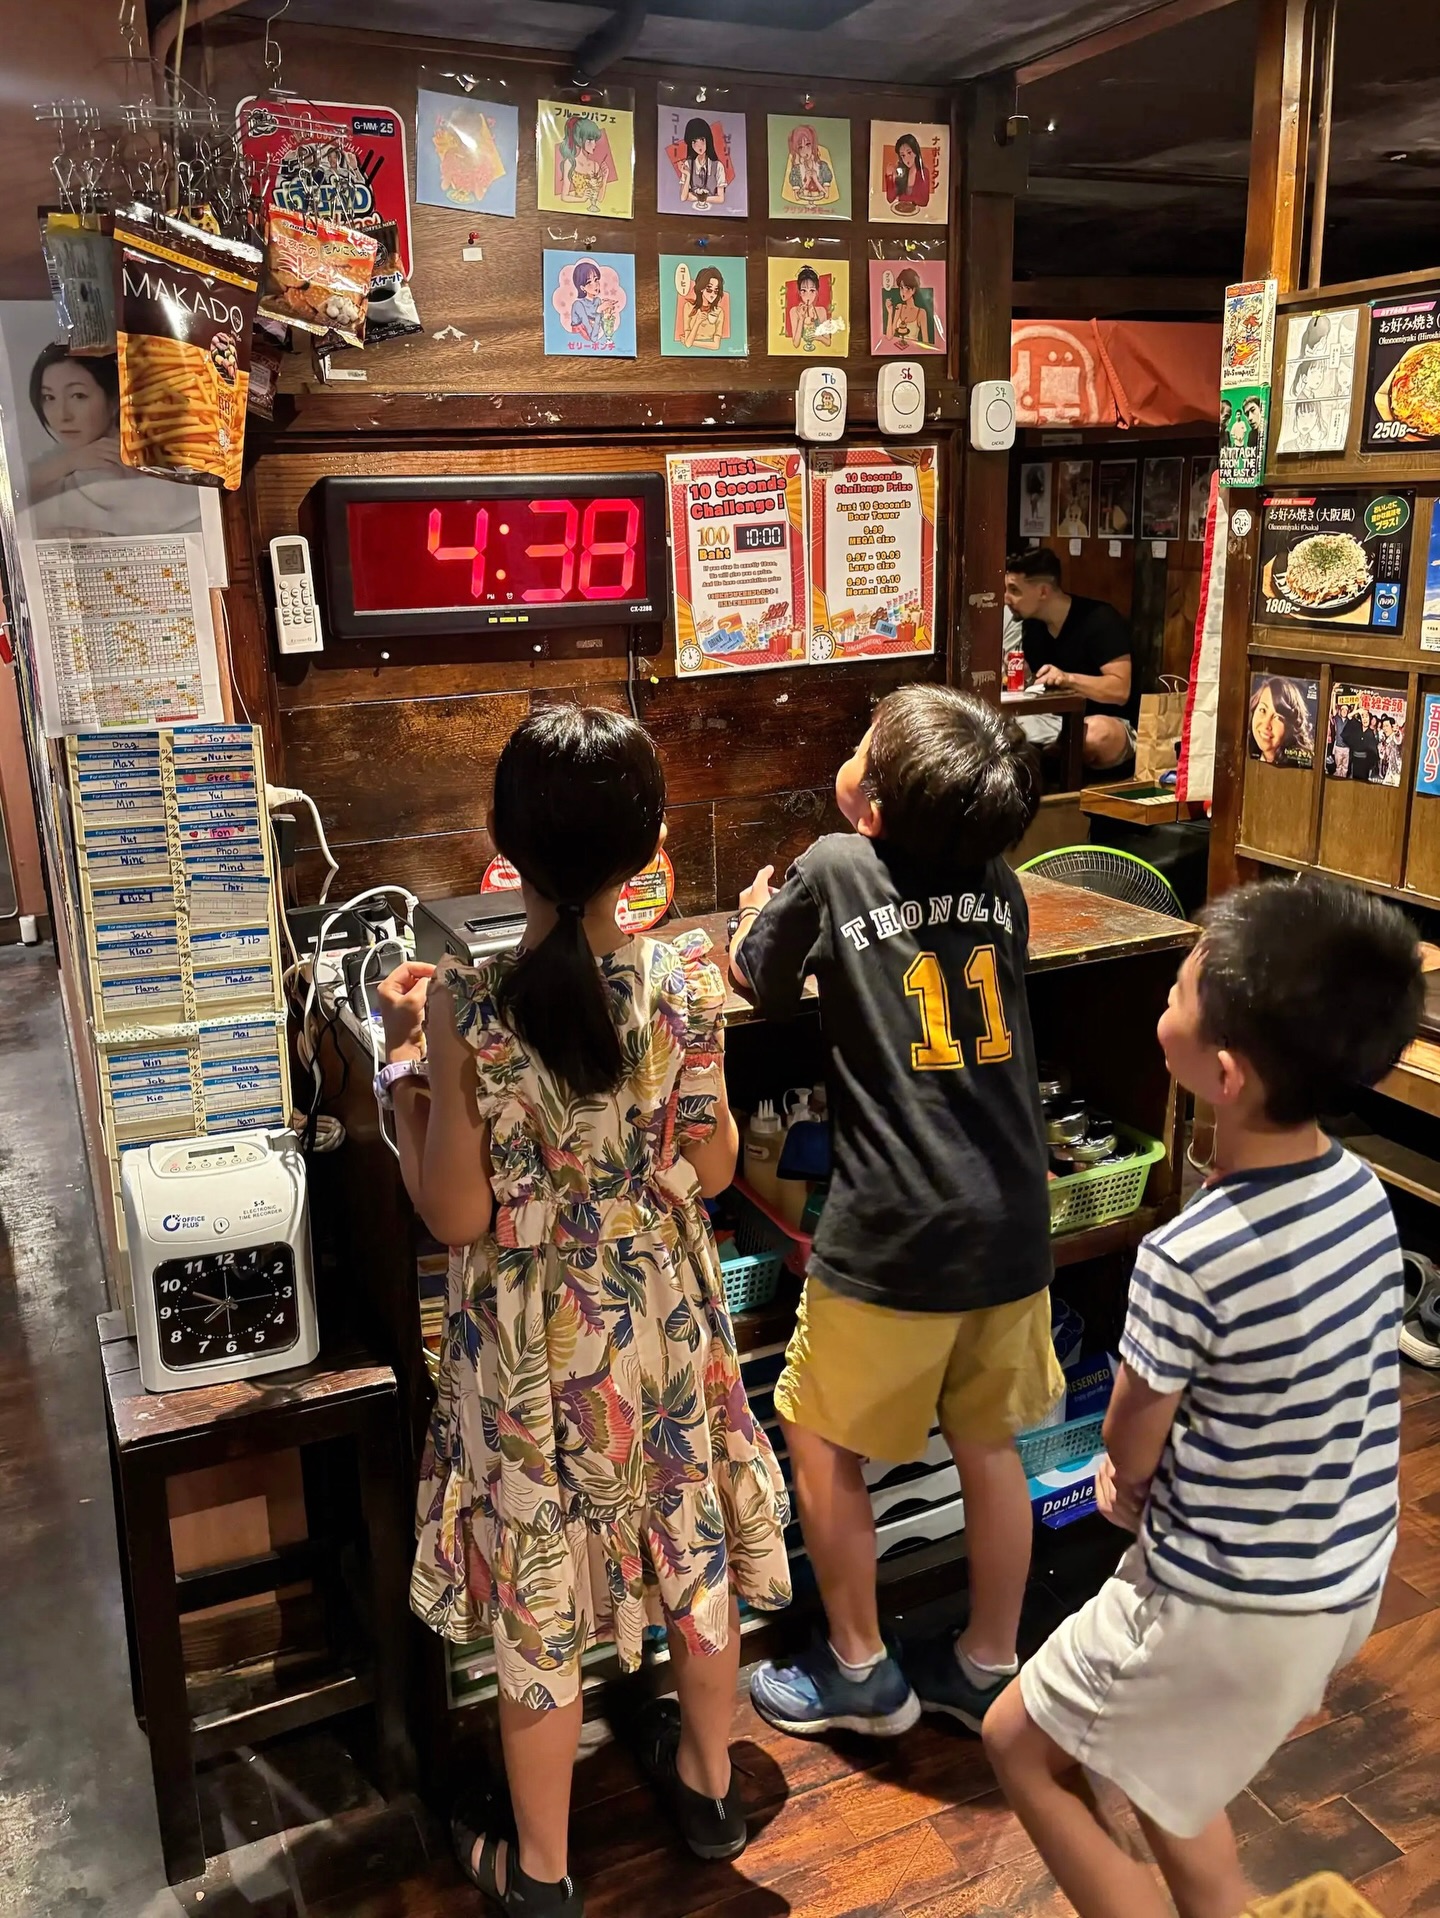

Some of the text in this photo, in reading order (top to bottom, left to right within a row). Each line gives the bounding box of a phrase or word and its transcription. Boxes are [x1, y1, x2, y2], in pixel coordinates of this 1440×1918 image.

[554, 107, 617, 124] フルーツパフェ
[379, 122, 395, 134] 25
[931, 136, 941, 190] ナポリタン
[122, 268, 245, 333] MAKADO
[1378, 333, 1417, 345] Okonomiyaki
[567, 341, 616, 351] ゼリーポンチ
[1220, 446, 1256, 459] ATTACK
[719, 459, 756, 478] Just
[1220, 459, 1255, 468] FROM THE
[845, 471, 902, 482] 10 Seconds
[1220, 469, 1231, 477] FAR
[1233, 469, 1249, 477] EAST
[690, 475, 787, 500] 10 Seconds
[835, 483, 913, 494] Challenge Prize
[691, 498, 775, 520] Challenge
[837, 500, 911, 512] Just 10 Seconds
[848, 511, 900, 521] Beer Tower
[864, 525, 884, 535] 9.99
[697, 526, 730, 547] 100
[746, 527, 780, 547] 10:00
[849, 535, 896, 545] MEGA size
[428, 499, 639, 601] 4:38
[698, 547, 731, 561] Baht
[846, 553, 866, 562] 9.97
[876, 550, 900, 560] 10.03
[848, 561, 896, 572] Large size
[847, 577, 867, 586] 9.90
[876, 575, 901, 584] 10.10
[846, 585, 898, 596] Normal size
[1360, 694, 1404, 713] 電線音頭
[112, 760, 135, 768] Max
[117, 799, 135, 808] Min
[902, 944, 1012, 1072] 11
[243, 1204, 277, 1215] ELECTRONIC
[252, 1208, 283, 1219] RECORDER
[182, 1216, 205, 1224] OFFICE
[215, 1253, 235, 1265] 12
[248, 1251, 257, 1263] 1
[184, 1260, 203, 1275] 11
[273, 1262, 284, 1274] 2
[160, 1279, 181, 1292] 10
[282, 1286, 292, 1298] 3
[160, 1307, 172, 1319] 9
[273, 1313, 284, 1325] 4
[170, 1331, 182, 1343] 8
[254, 1331, 265, 1343] 5
[199, 1340, 210, 1353] 7
[226, 1340, 237, 1353] 6
[1042, 1485, 1093, 1516] Double
